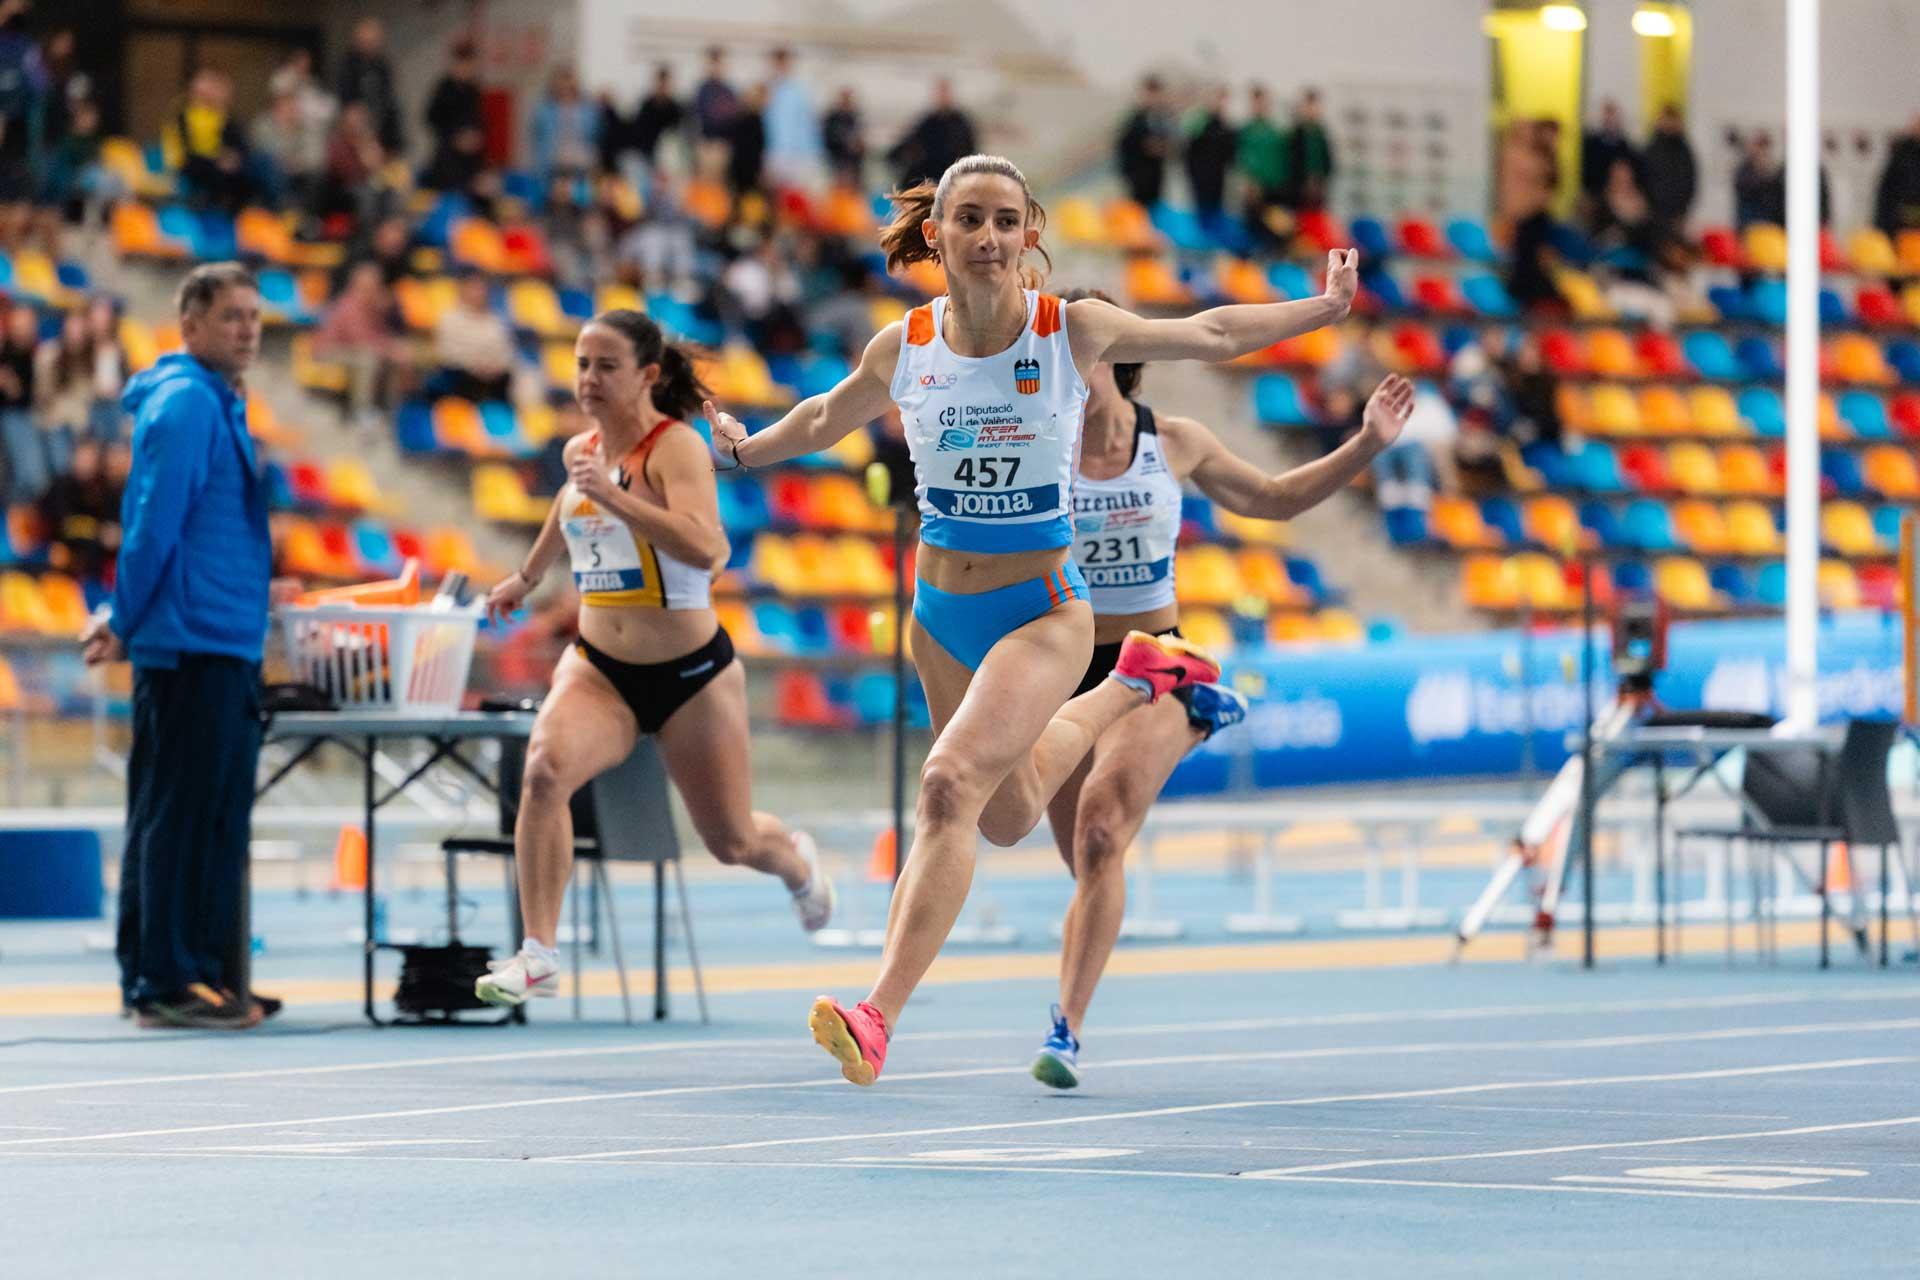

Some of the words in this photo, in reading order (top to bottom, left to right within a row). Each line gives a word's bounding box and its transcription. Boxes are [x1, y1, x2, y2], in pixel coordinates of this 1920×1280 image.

[966, 404, 1014, 416] Diputació
[966, 418, 979, 426] de
[981, 415, 1023, 426] València
[981, 425, 1019, 434] RFEA
[978, 434, 1036, 442] ATLETISMO
[954, 457, 1021, 488] 457
[591, 542, 601, 568] 5
[1083, 536, 1140, 563] 231
